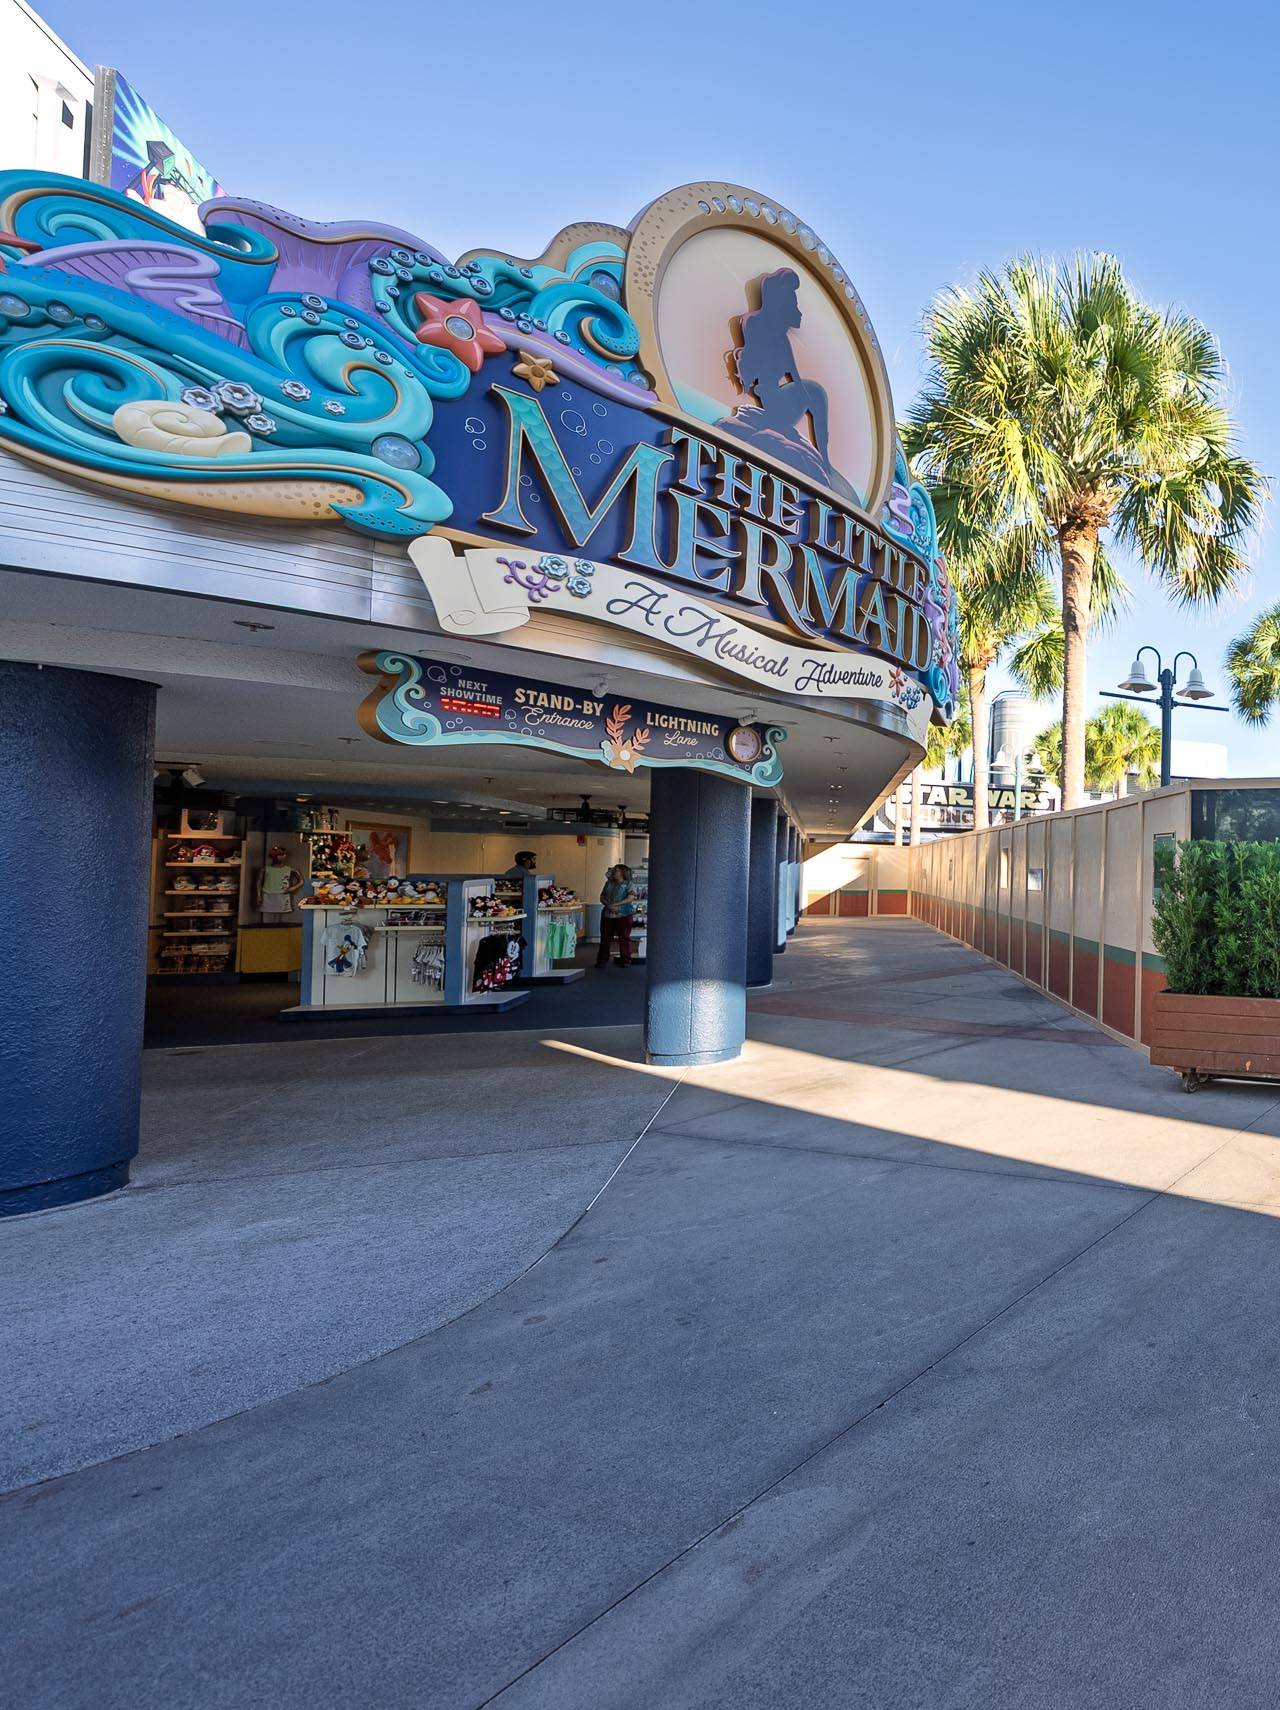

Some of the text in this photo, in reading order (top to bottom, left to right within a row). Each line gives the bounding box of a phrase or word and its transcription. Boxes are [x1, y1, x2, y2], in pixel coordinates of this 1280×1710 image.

[481, 383, 933, 672] MERMAID
[671, 426, 931, 606] THE LITTLE
[606, 581, 884, 693] A Musical Adventure
[440, 686, 503, 705] SHOWTIME
[458, 679, 488, 692] NEXT
[514, 687, 604, 717] STAND-BY
[521, 706, 594, 730] Entrance
[647, 712, 719, 737] LIGHTNING
[664, 730, 698, 746] Lane
